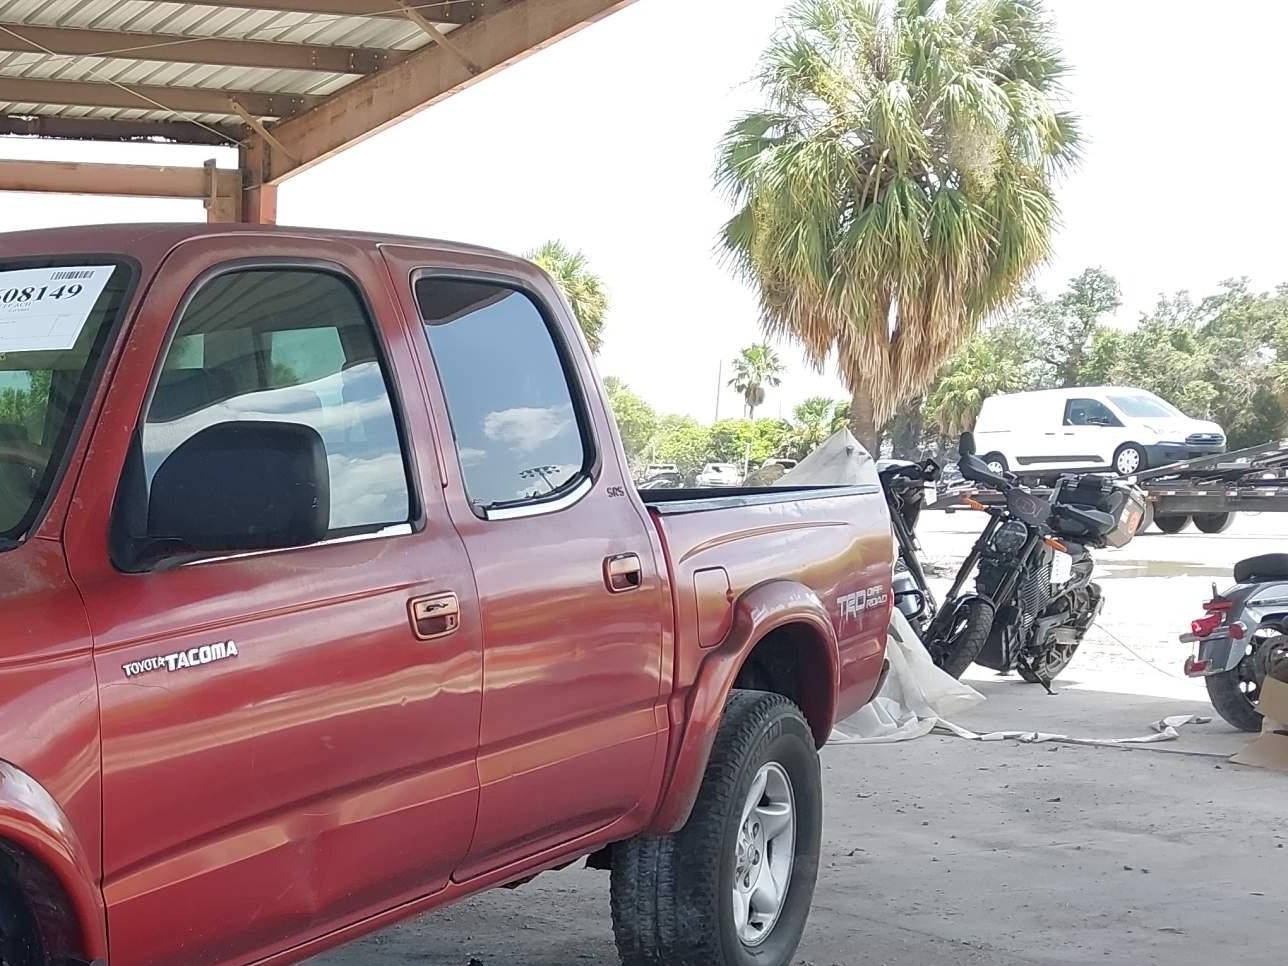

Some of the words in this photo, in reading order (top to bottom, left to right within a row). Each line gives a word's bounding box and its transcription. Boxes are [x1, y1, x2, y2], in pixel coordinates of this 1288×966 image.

[606, 486, 625, 498] SRS
[837, 589, 867, 619] TRD
[866, 594, 888, 608] ROAD
[123, 656, 165, 677] TOYOTA
[165, 640, 238, 672] TACOMA
